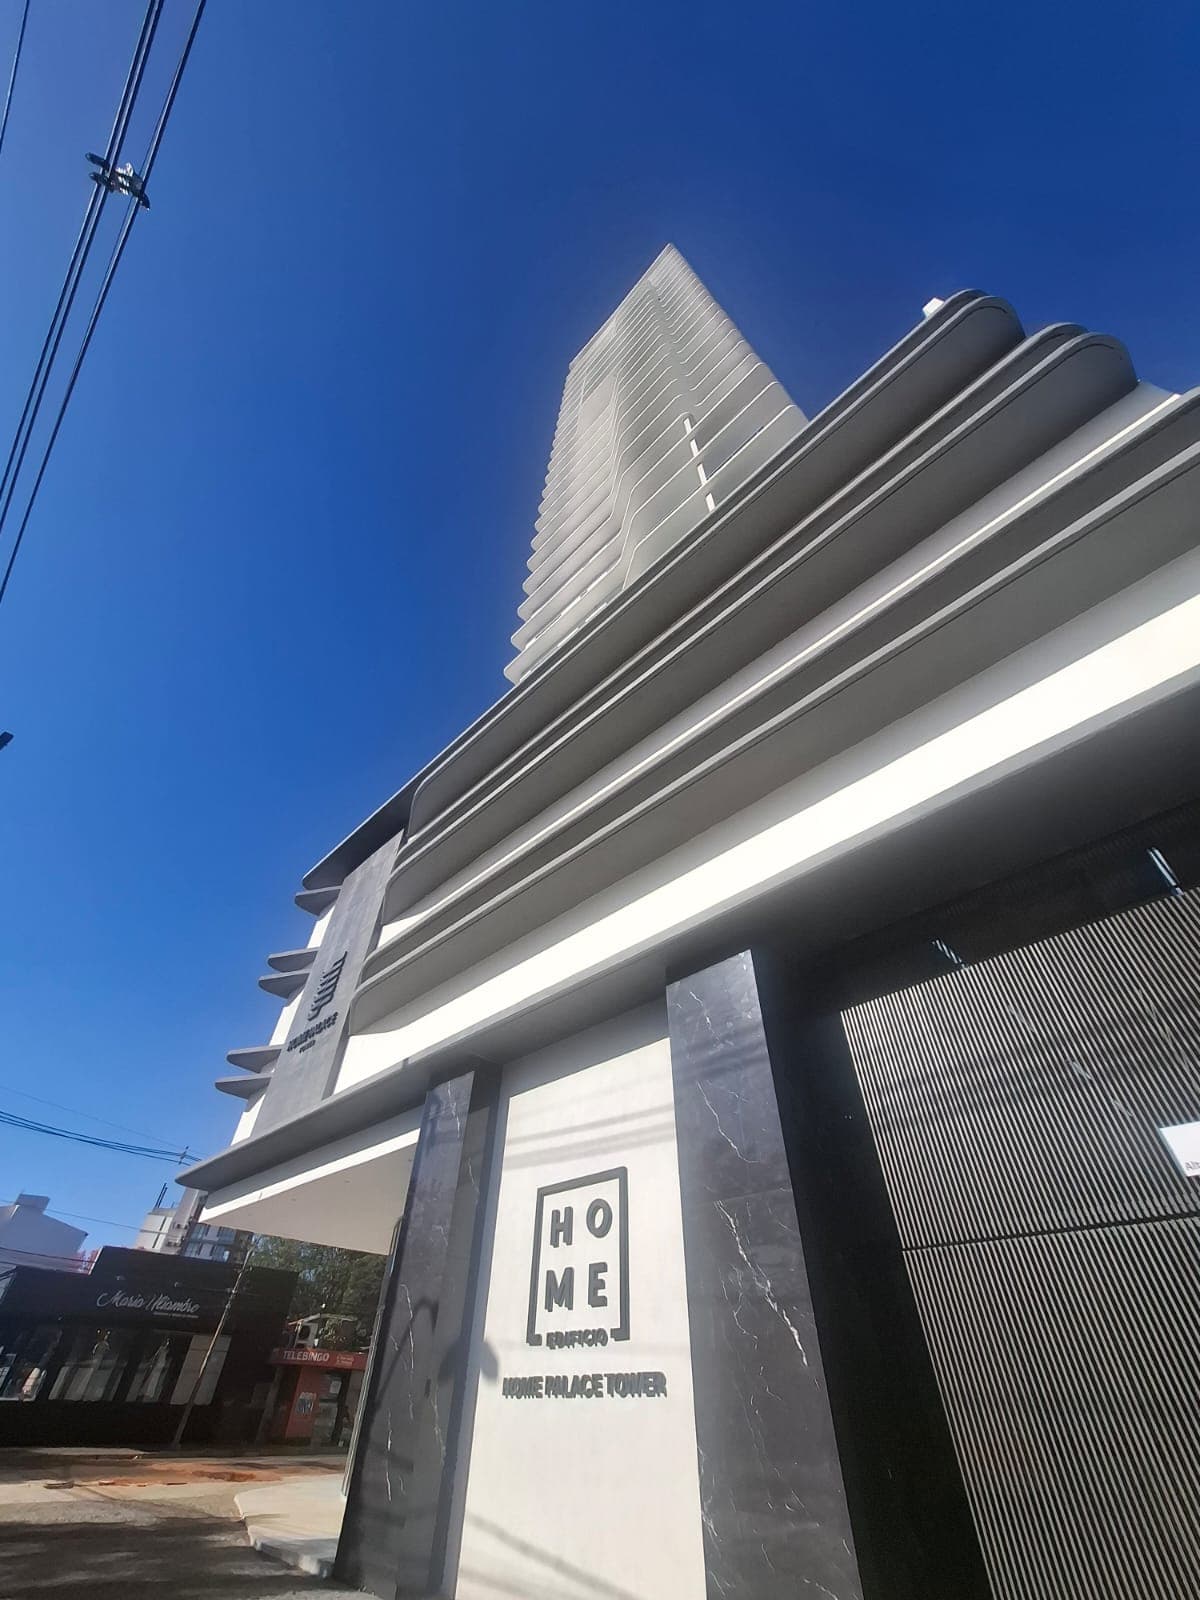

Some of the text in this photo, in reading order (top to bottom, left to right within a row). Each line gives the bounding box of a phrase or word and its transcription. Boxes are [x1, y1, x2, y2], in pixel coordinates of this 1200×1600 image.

[546, 1328, 609, 1350] EDIFICIO
[283, 1350, 330, 1362] TELEBINGO
[502, 1371, 668, 1400] HOME PALACE TOWER
